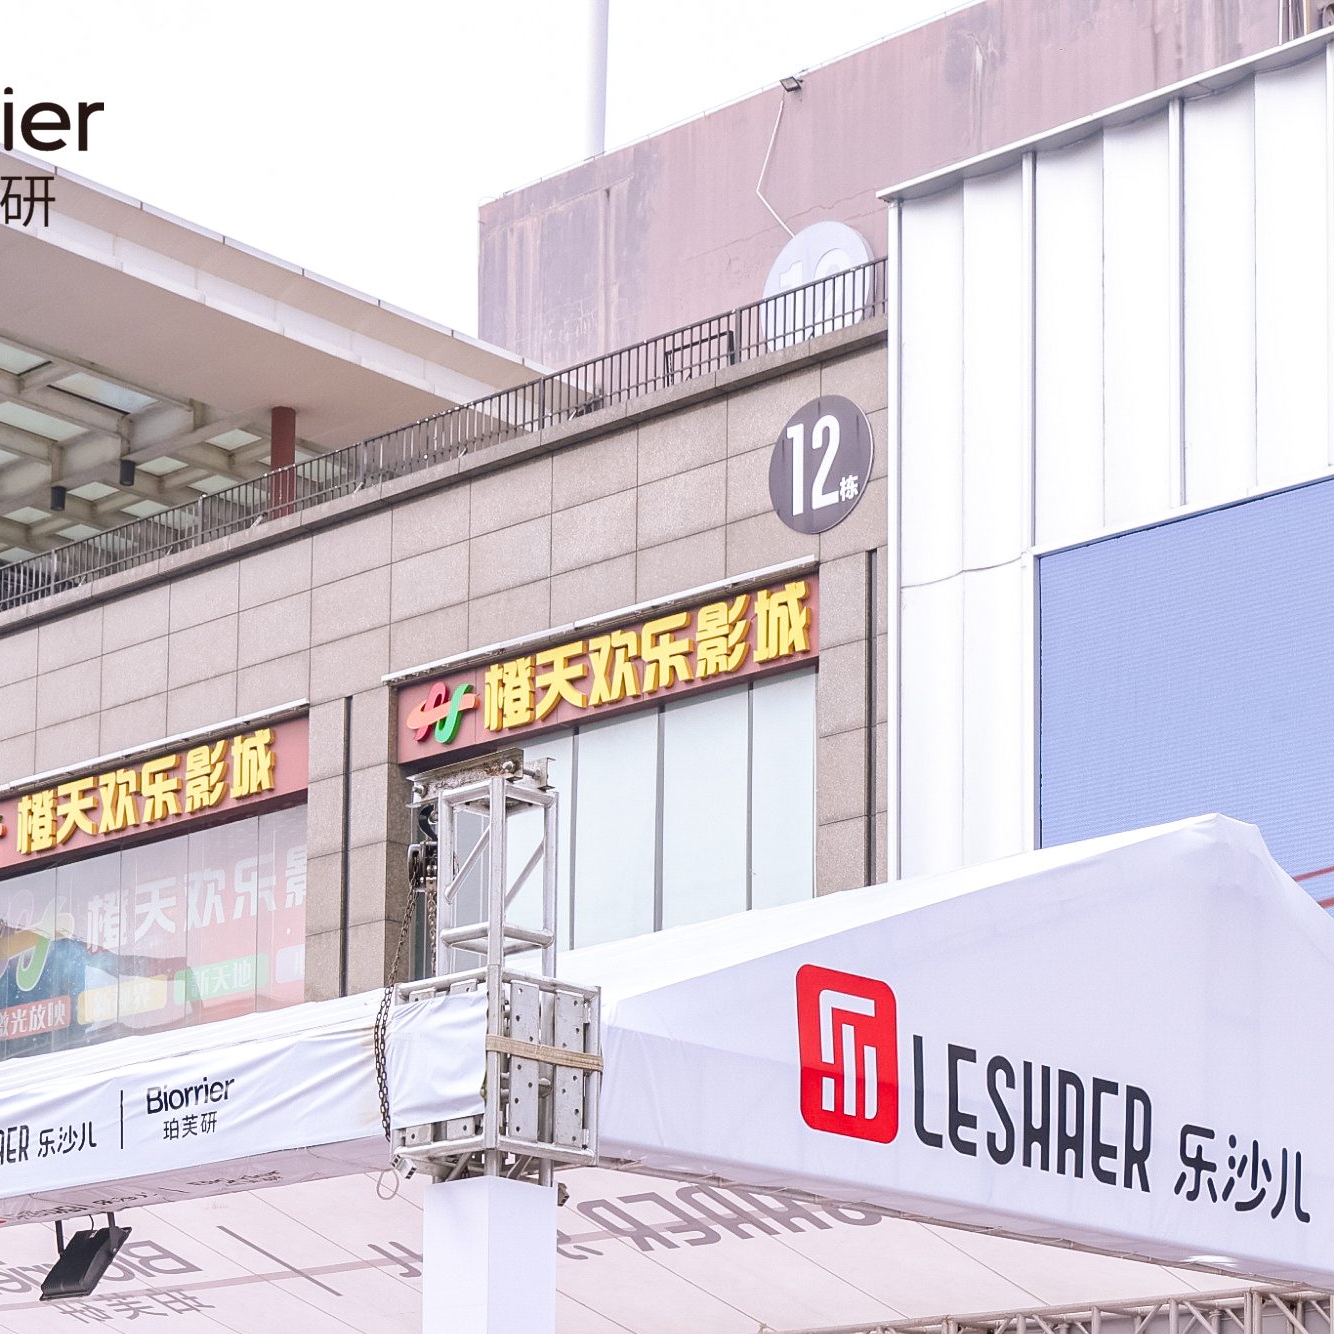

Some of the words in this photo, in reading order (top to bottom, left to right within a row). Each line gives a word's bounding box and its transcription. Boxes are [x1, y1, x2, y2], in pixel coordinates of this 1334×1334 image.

[483, 580, 811, 734] 橙天欢乐影城
[16, 728, 276, 856] 橙天欢乐影城
[146, 1077, 234, 1116] Biorrier
[163, 1111, 218, 1141] 珀芙研
[37, 1121, 97, 1158] 乐沙儿
[1174, 1123, 1310, 1224] 乐沙儿
